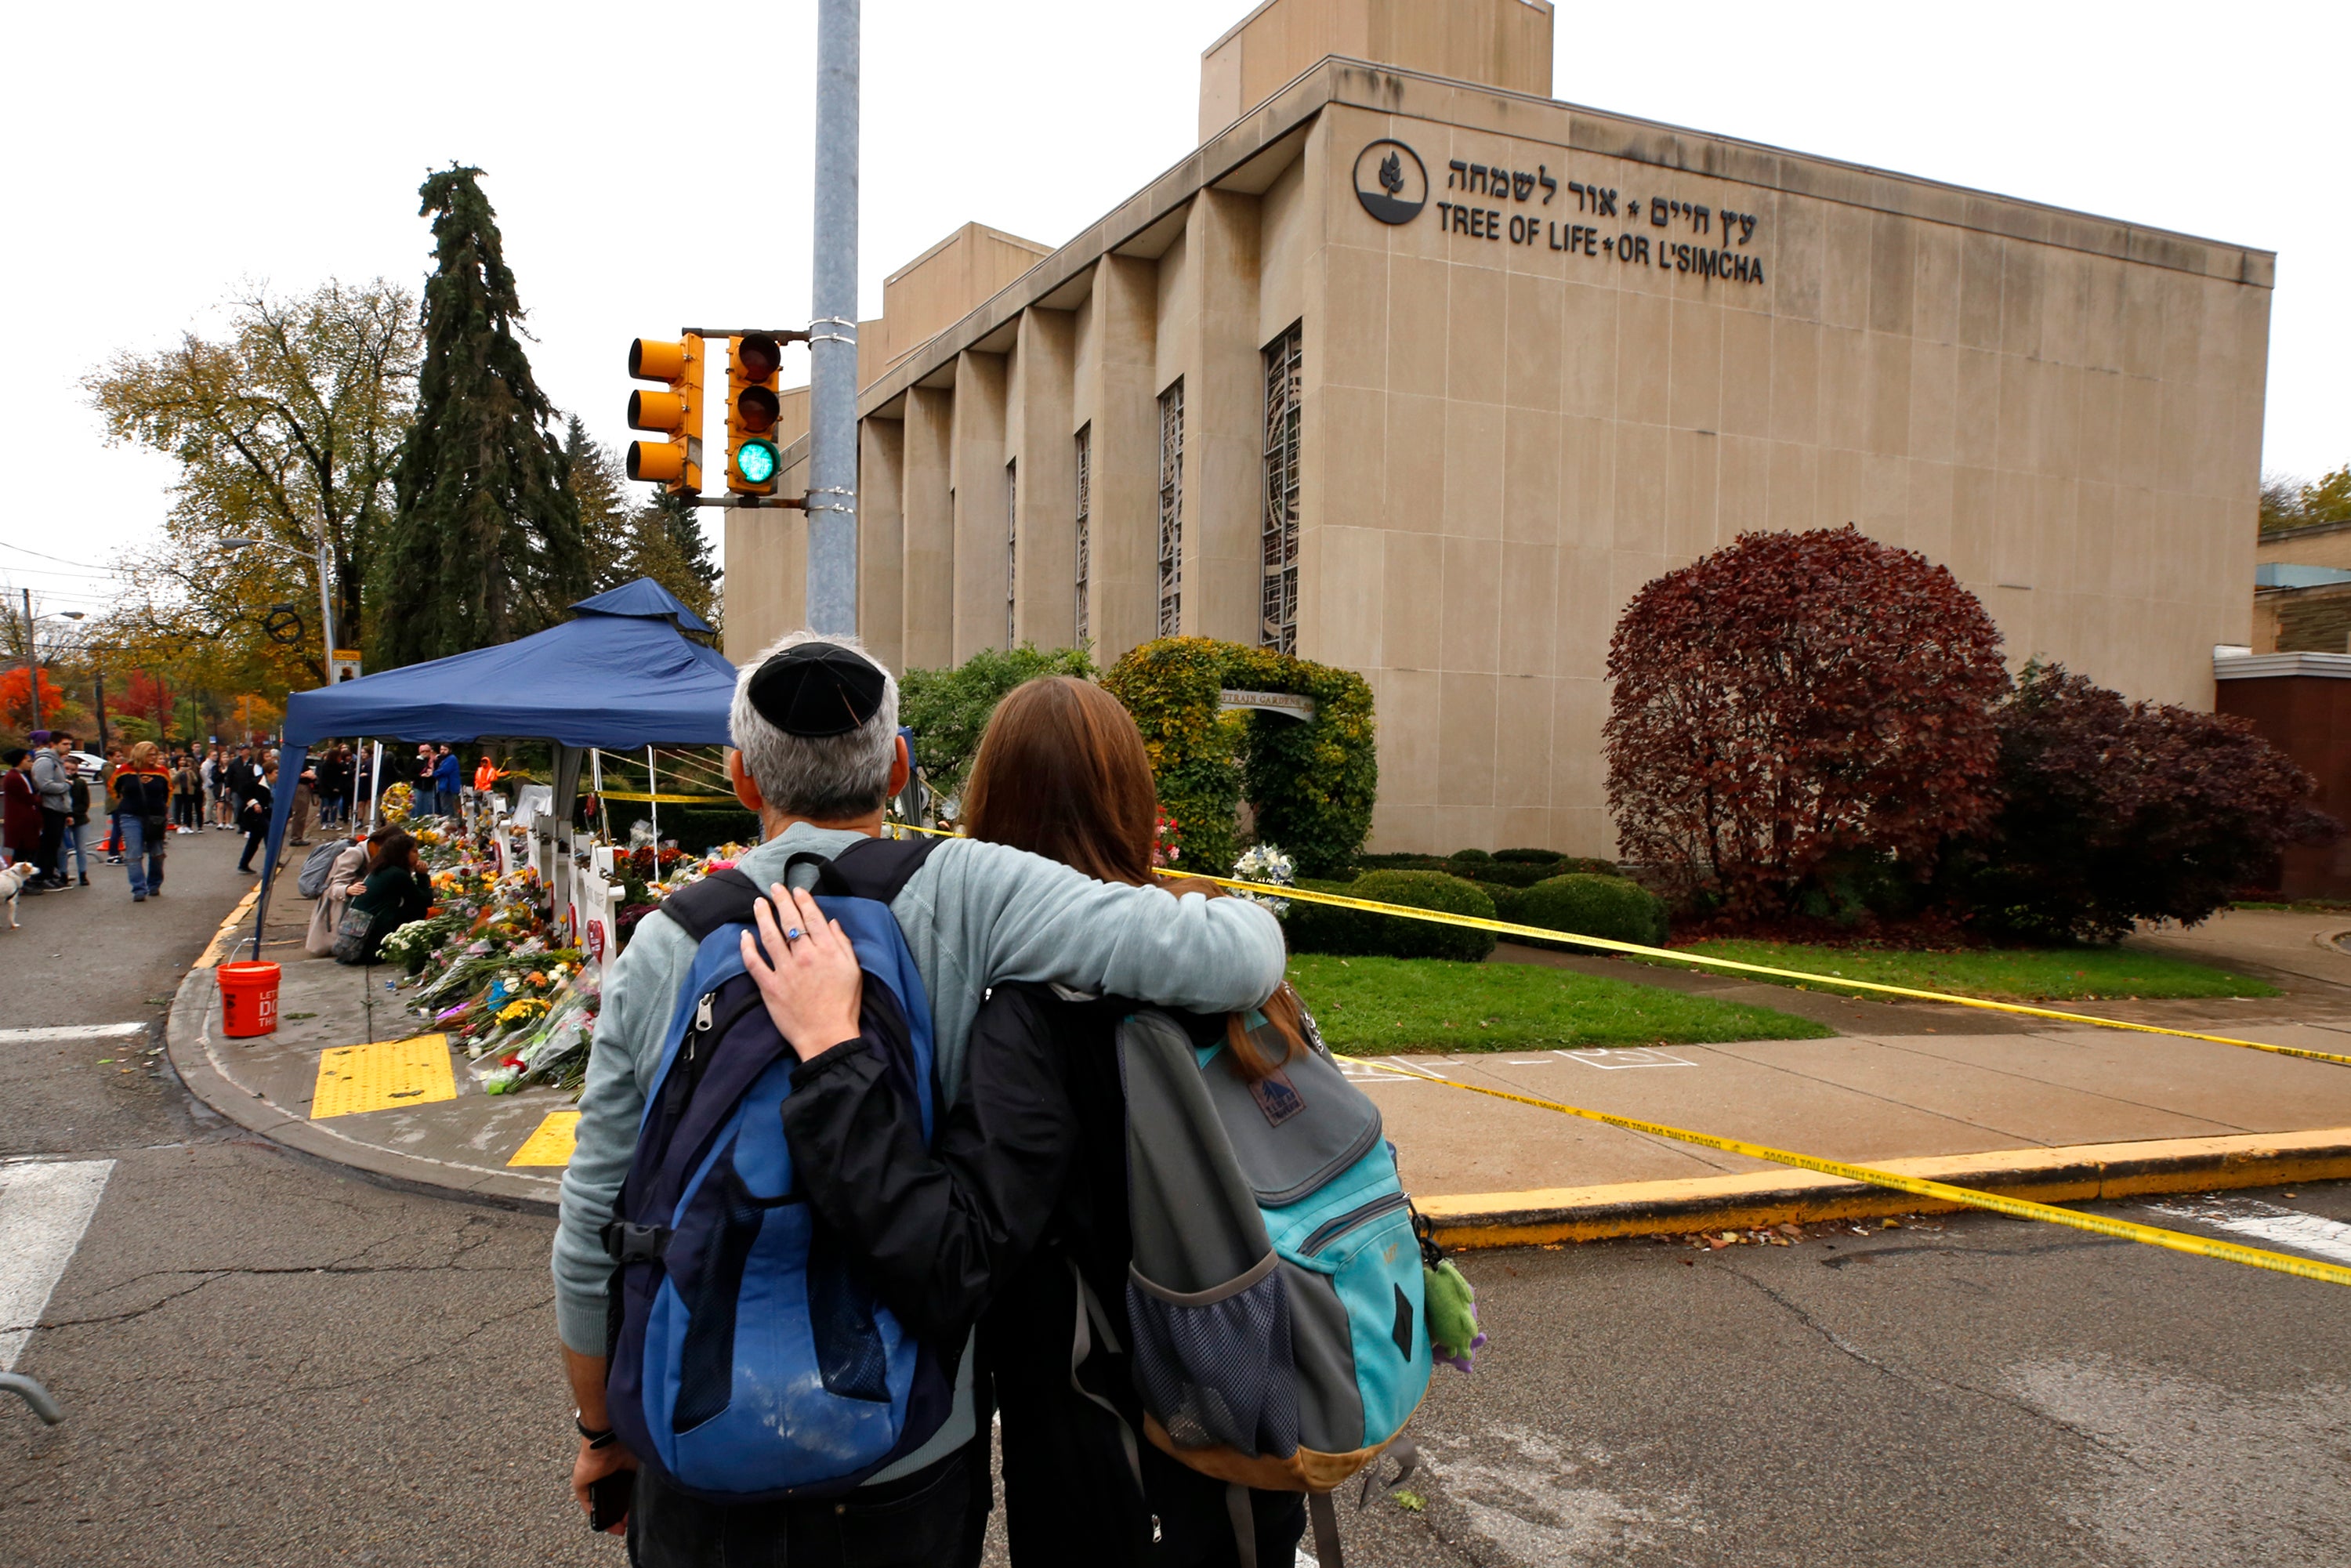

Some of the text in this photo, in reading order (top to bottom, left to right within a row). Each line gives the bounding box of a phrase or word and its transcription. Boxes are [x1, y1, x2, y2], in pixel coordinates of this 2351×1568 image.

[1437, 201, 1765, 284] TREE OF LIFE OR L'SIMCHA
[1448, 158, 1758, 247] עץ חיים אור לשמחה
[1259, 695, 1301, 705] GARDENS
